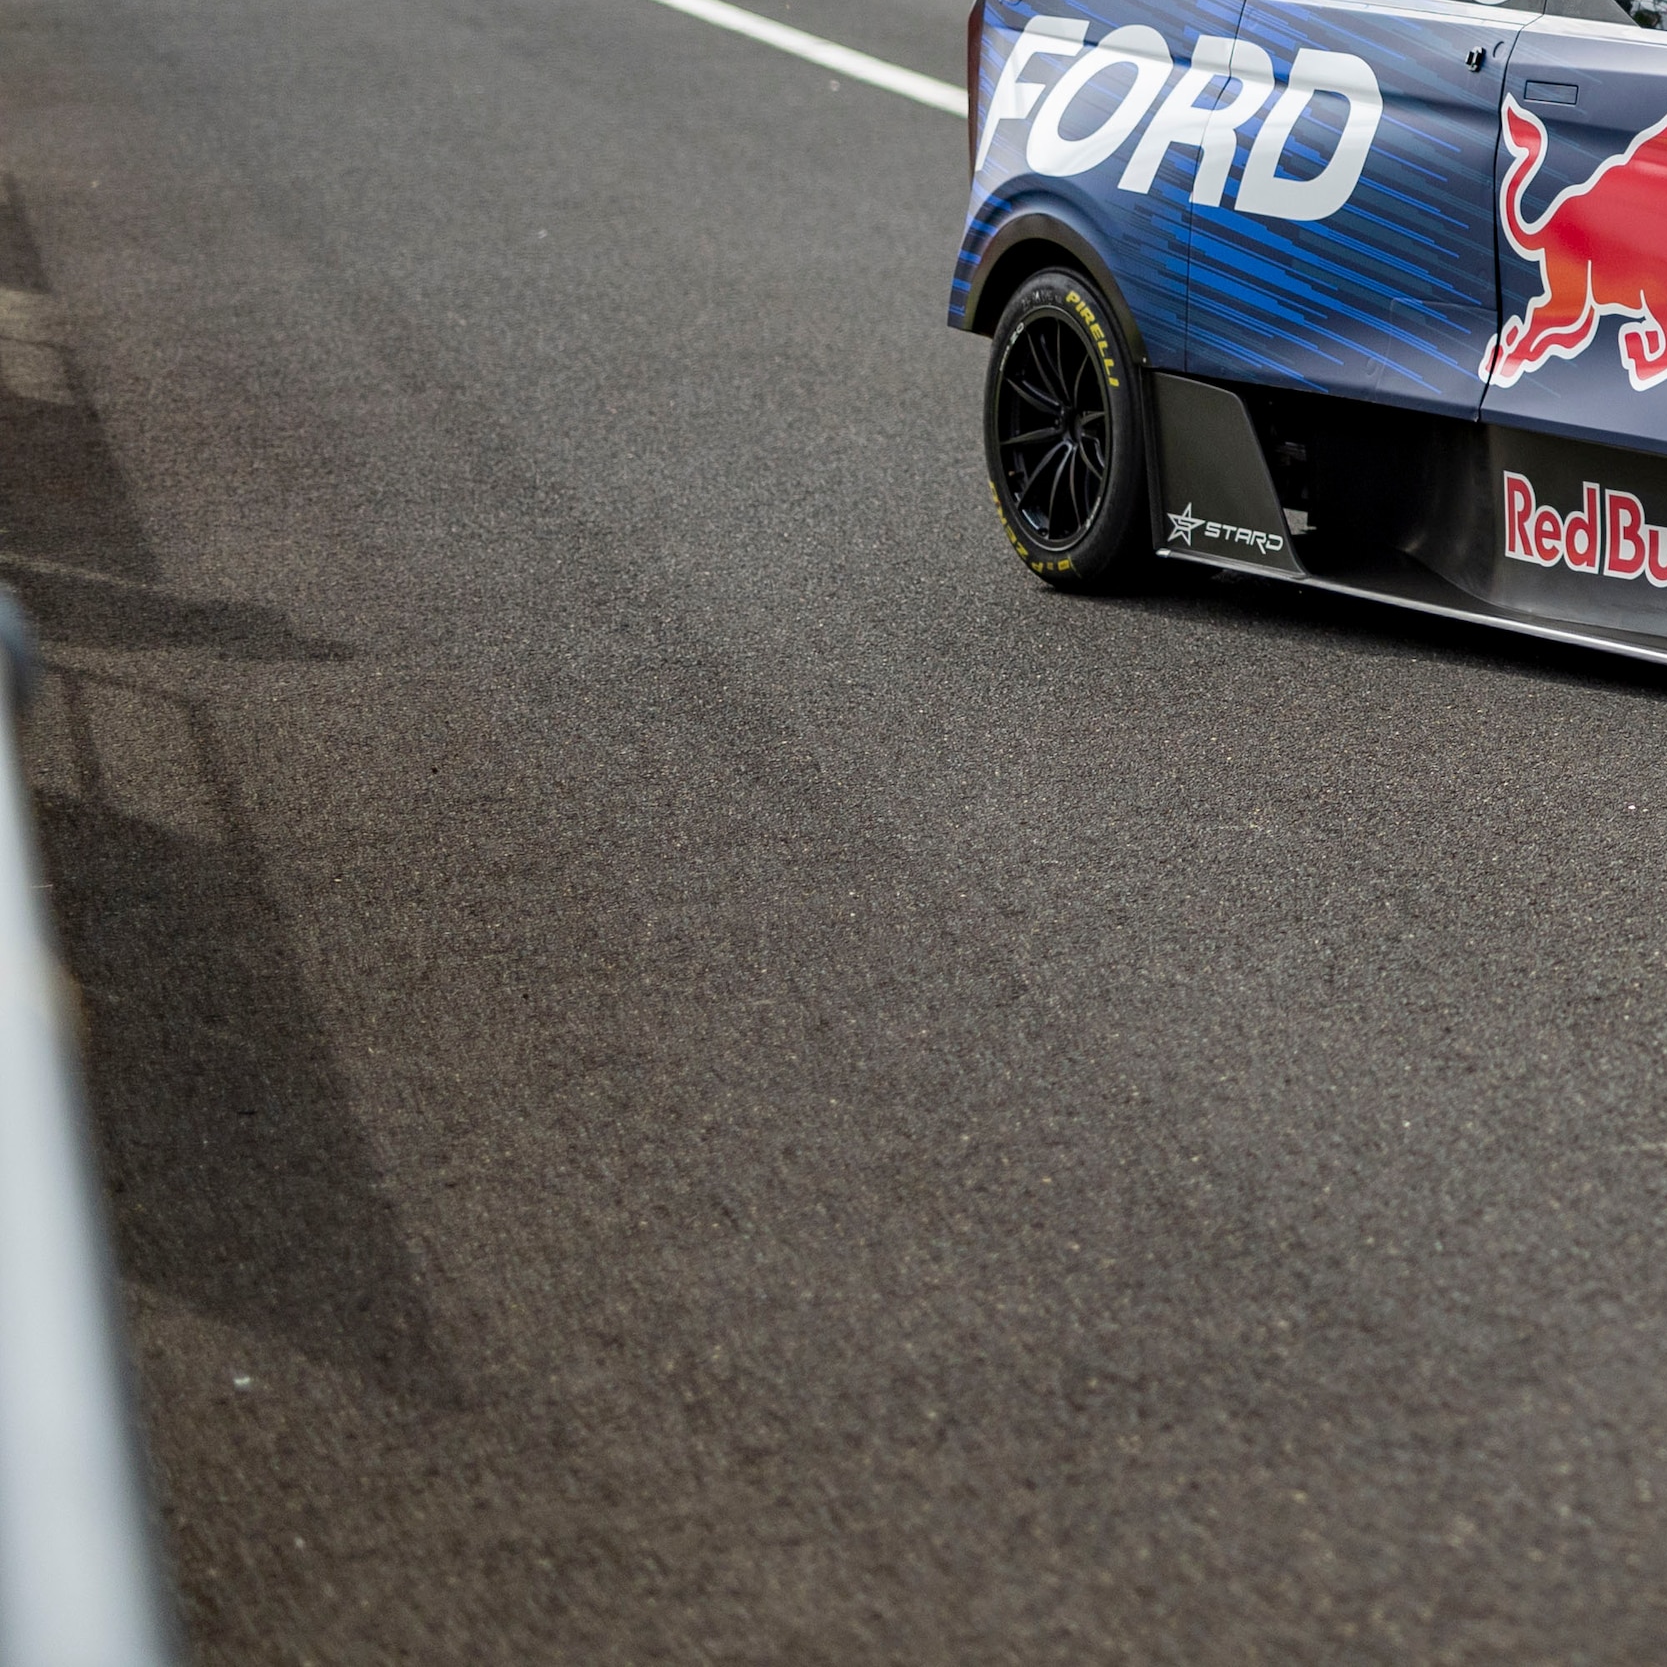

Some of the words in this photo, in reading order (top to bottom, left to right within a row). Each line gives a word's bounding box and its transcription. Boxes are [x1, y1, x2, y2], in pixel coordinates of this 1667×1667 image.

[975, 15, 1384, 222] FORD
[1066, 291, 1120, 388] PIRELLI
[1204, 521, 1283, 554] STARD
